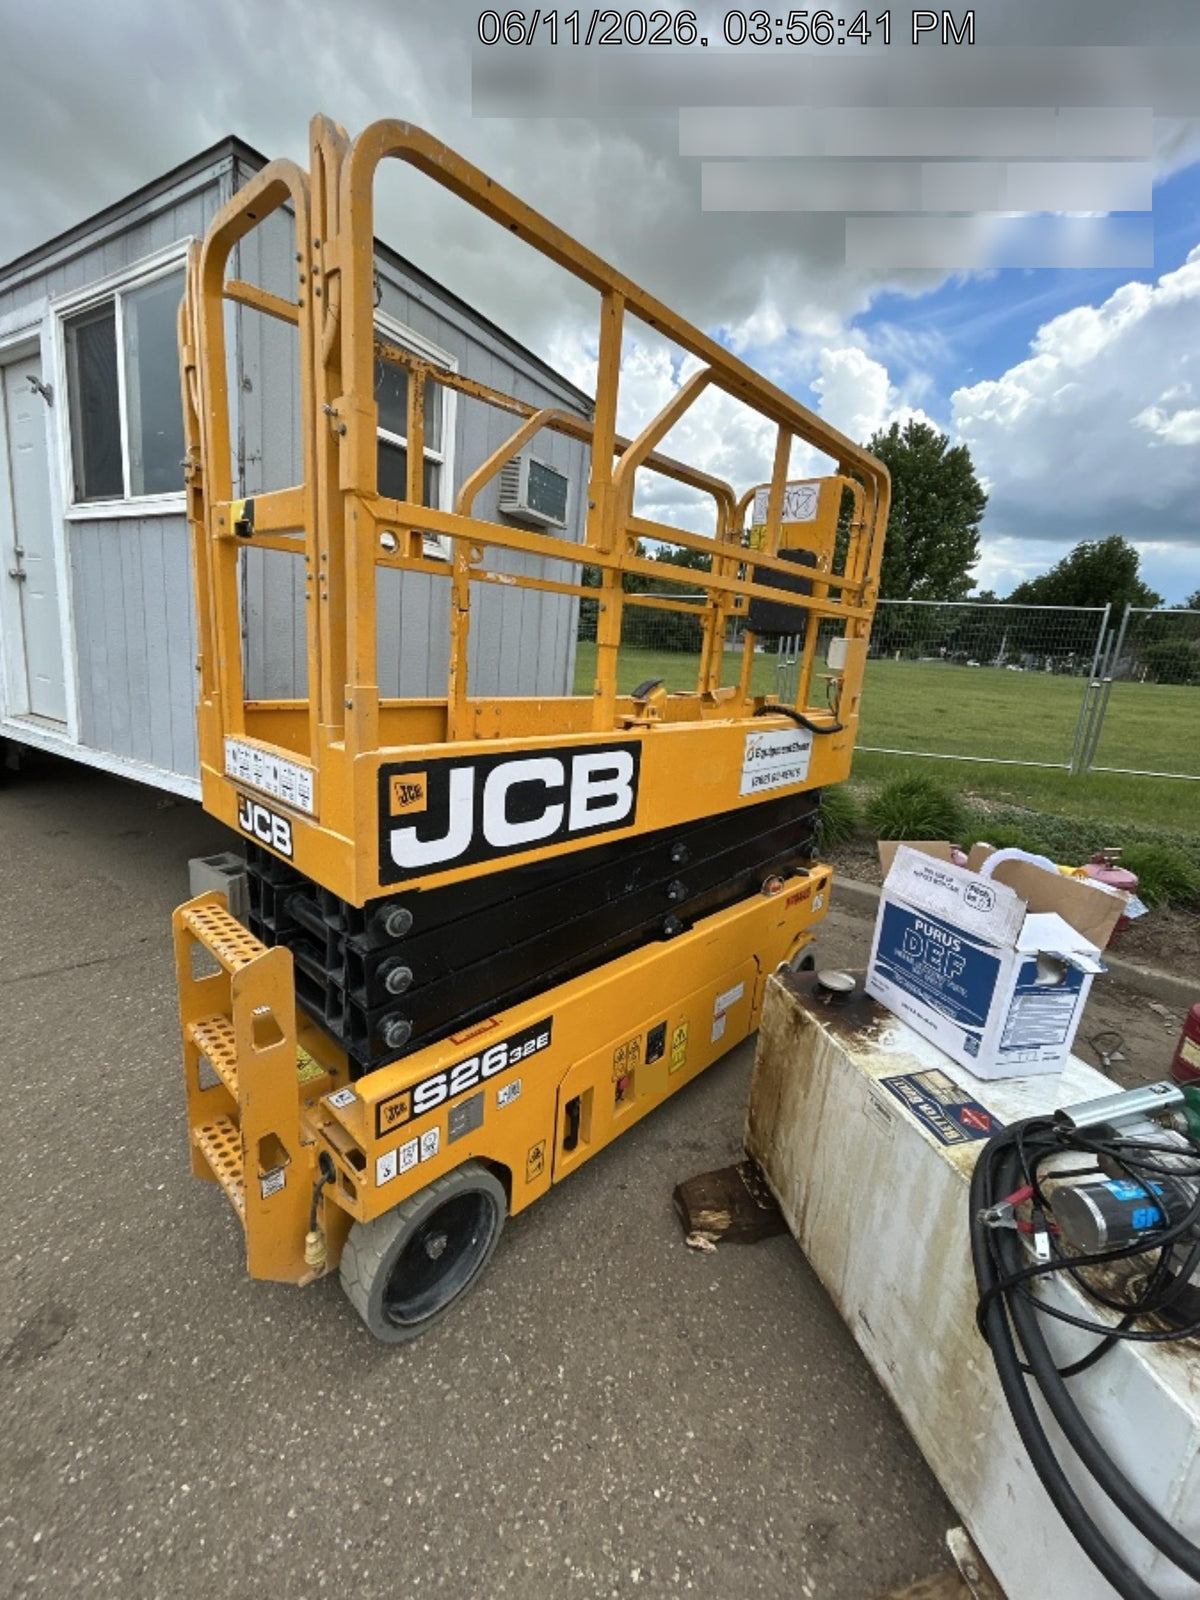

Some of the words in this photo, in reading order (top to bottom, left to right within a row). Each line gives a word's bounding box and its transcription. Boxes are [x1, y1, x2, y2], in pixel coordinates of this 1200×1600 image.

[239, 799, 292, 856] JCB
[390, 750, 634, 868] JCB
[915, 919, 961, 952] PURUS
